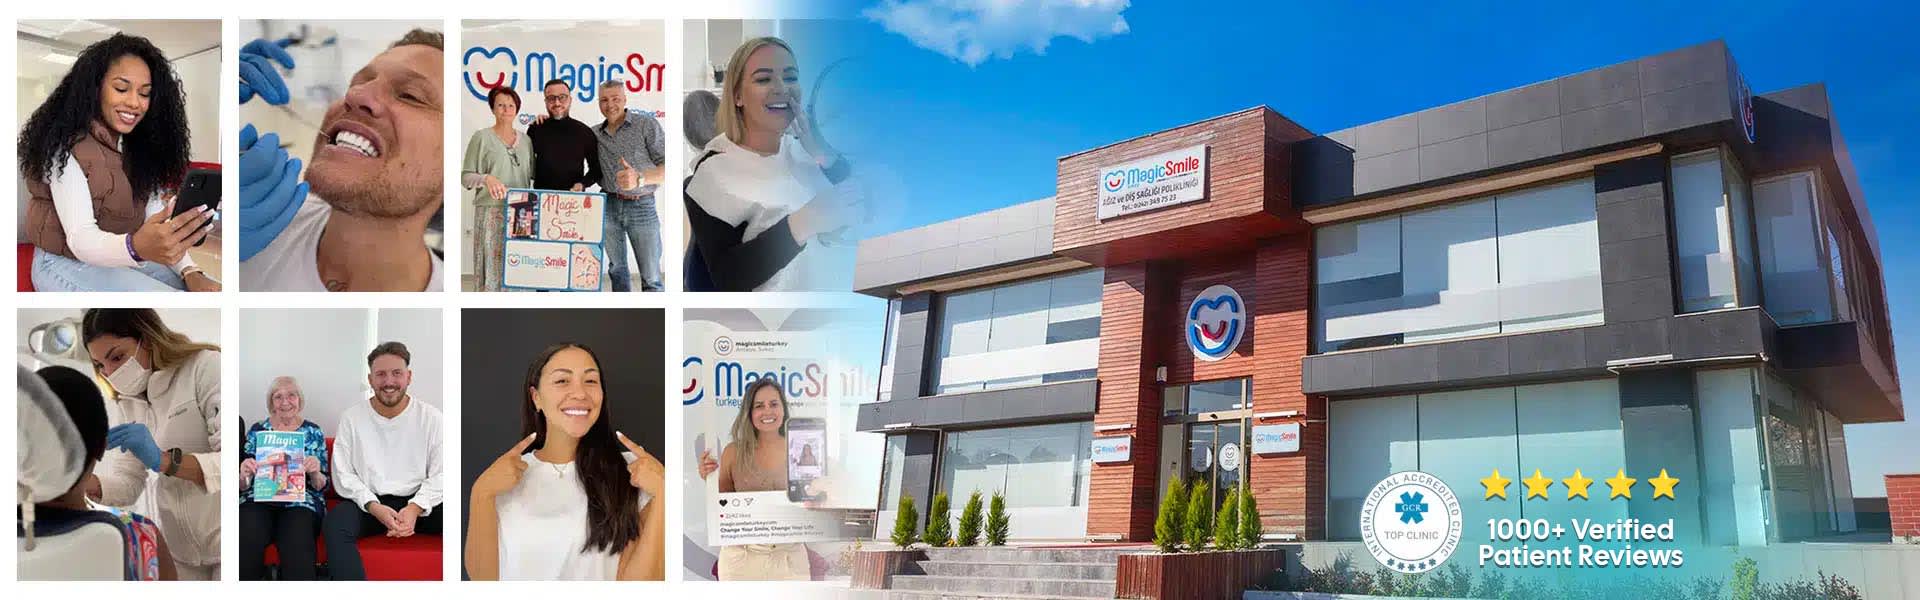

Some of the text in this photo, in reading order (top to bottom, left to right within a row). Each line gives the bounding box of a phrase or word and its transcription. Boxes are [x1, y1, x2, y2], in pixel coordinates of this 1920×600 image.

[1128, 156, 1200, 185] MagicSmile
[542, 194, 579, 217] Magic
[521, 255, 567, 267] MagicSmile
[264, 434, 298, 447] Magic
